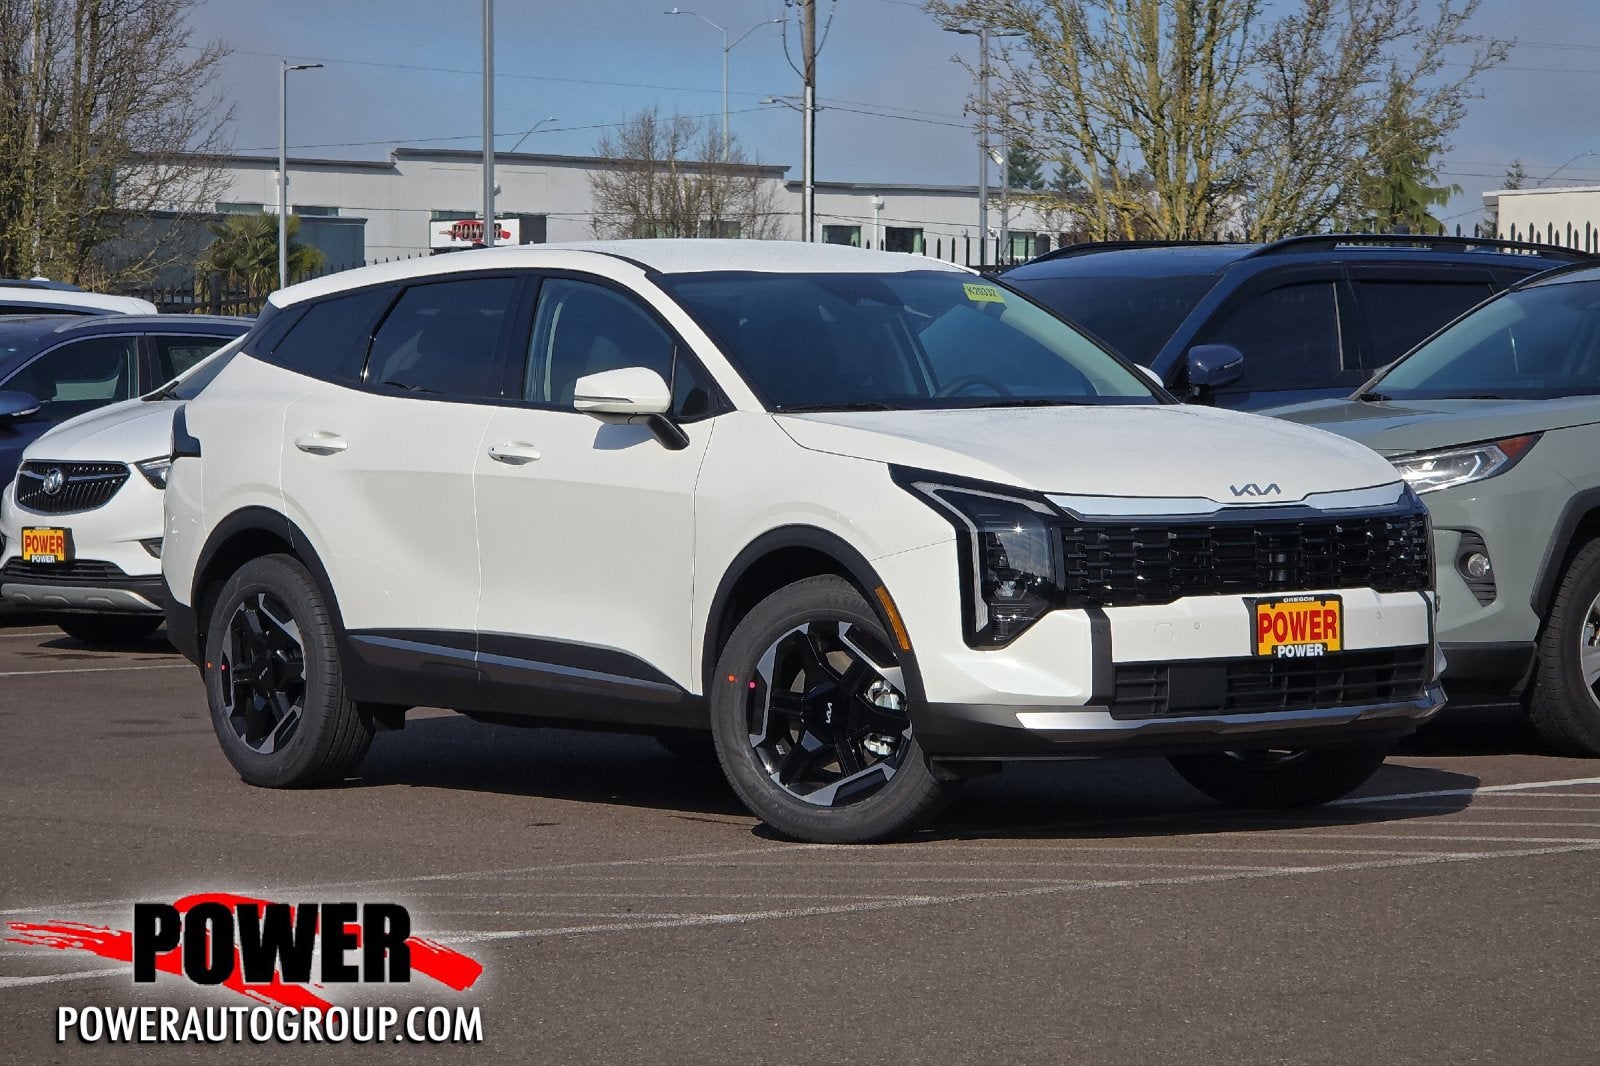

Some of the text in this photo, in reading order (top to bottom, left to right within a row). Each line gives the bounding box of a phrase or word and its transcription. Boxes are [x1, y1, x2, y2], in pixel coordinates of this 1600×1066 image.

[451, 223, 502, 241] POWR
[1229, 483, 1282, 497] KIA
[25, 535, 64, 554] POWER
[31, 554, 55, 564] POWER
[1258, 609, 1338, 644] POWER
[1277, 643, 1324, 658] POWER
